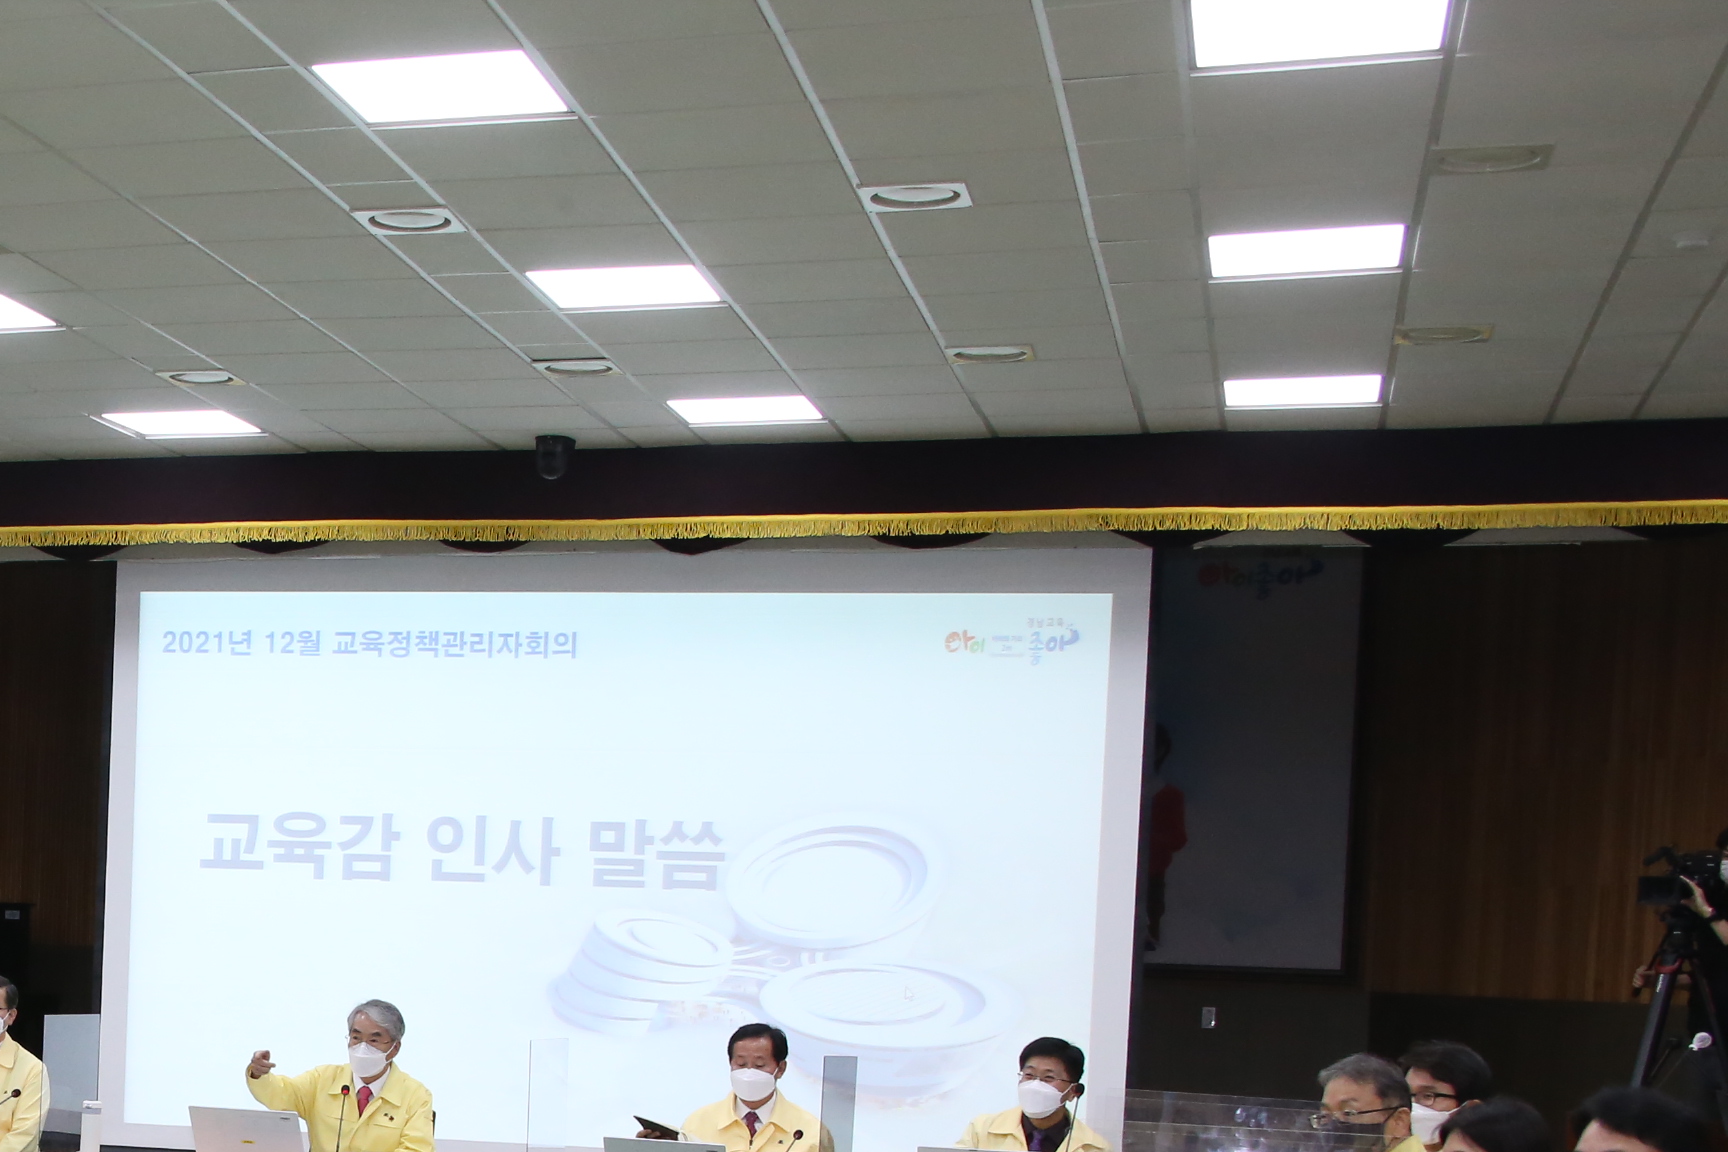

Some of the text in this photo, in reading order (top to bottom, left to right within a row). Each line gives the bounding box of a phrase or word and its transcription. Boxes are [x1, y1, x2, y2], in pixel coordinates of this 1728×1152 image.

[162, 630, 579, 659] 2021년 12월 교육정책관리자회의
[199, 811, 726, 892] 교육감 인사 말씀
